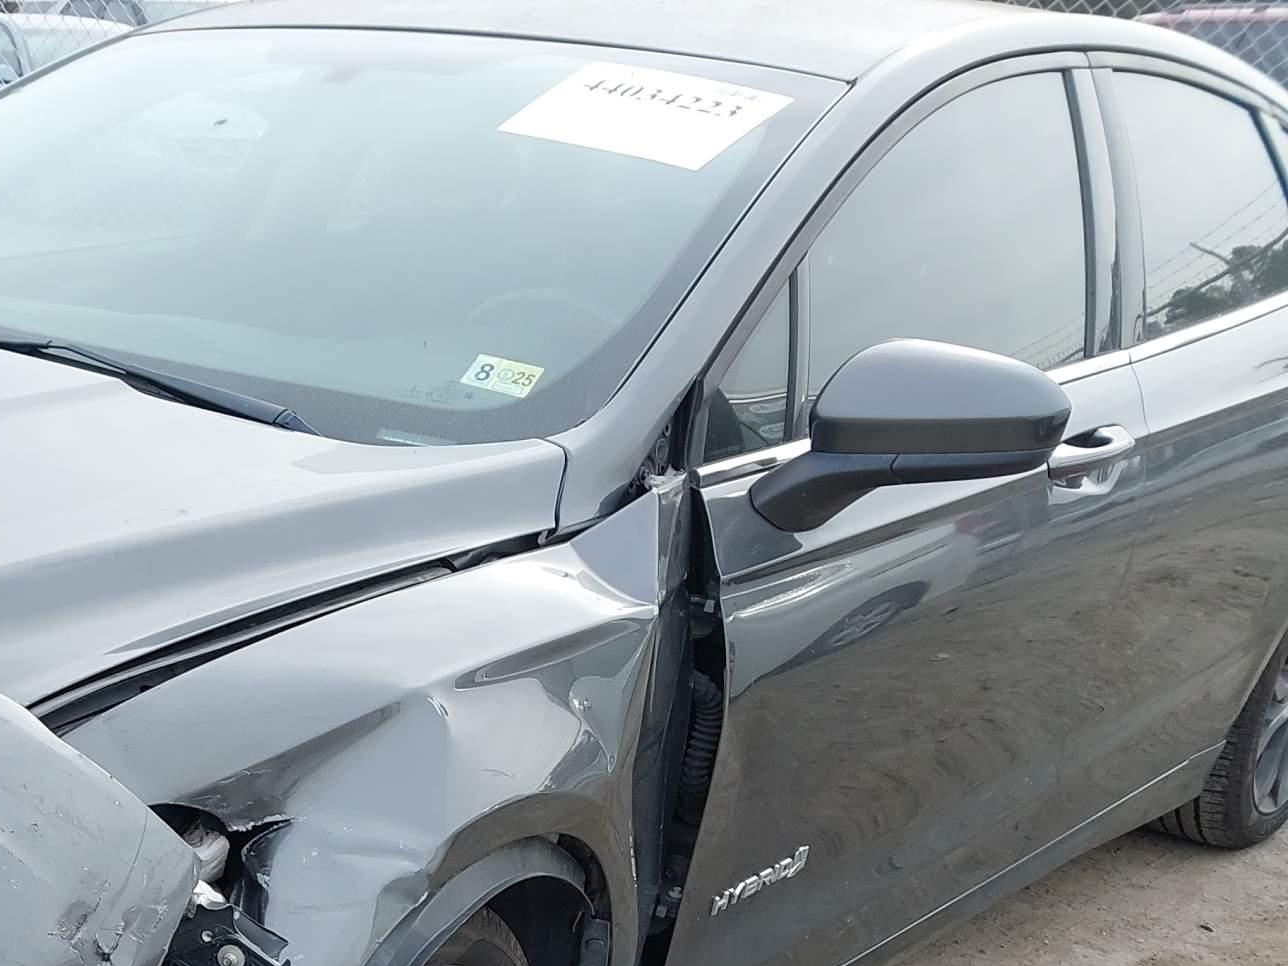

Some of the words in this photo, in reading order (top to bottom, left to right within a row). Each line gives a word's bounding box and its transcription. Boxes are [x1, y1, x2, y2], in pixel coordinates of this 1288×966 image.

[474, 363, 495, 381] 8
[511, 371, 536, 387] 25
[711, 857, 793, 916] HYBRID
